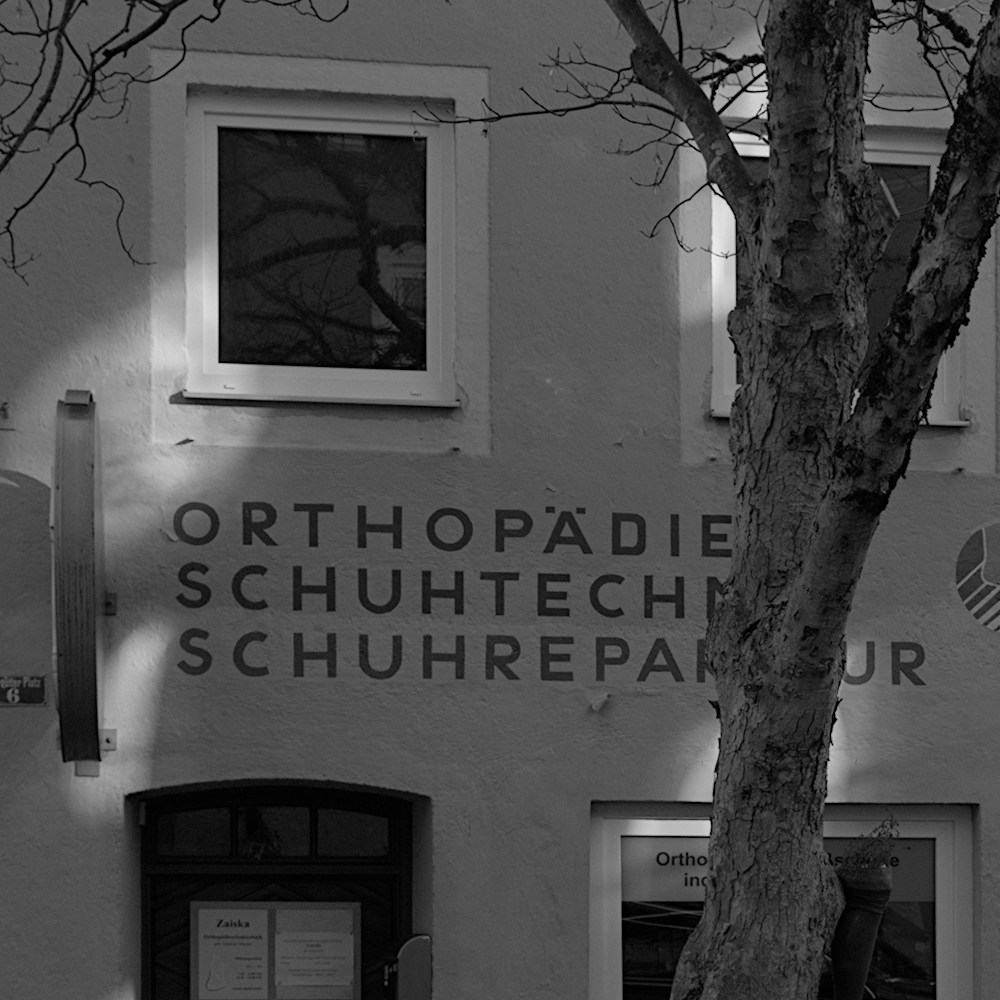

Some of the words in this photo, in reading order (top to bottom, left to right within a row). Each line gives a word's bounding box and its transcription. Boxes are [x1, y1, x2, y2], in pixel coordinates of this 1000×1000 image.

[173, 502, 733, 558] ORTHOPÄDIE
[175, 562, 726, 620] SCHUHTECH
[6, 687, 20, 704] 6
[216, 919, 250, 928] Zaiska
